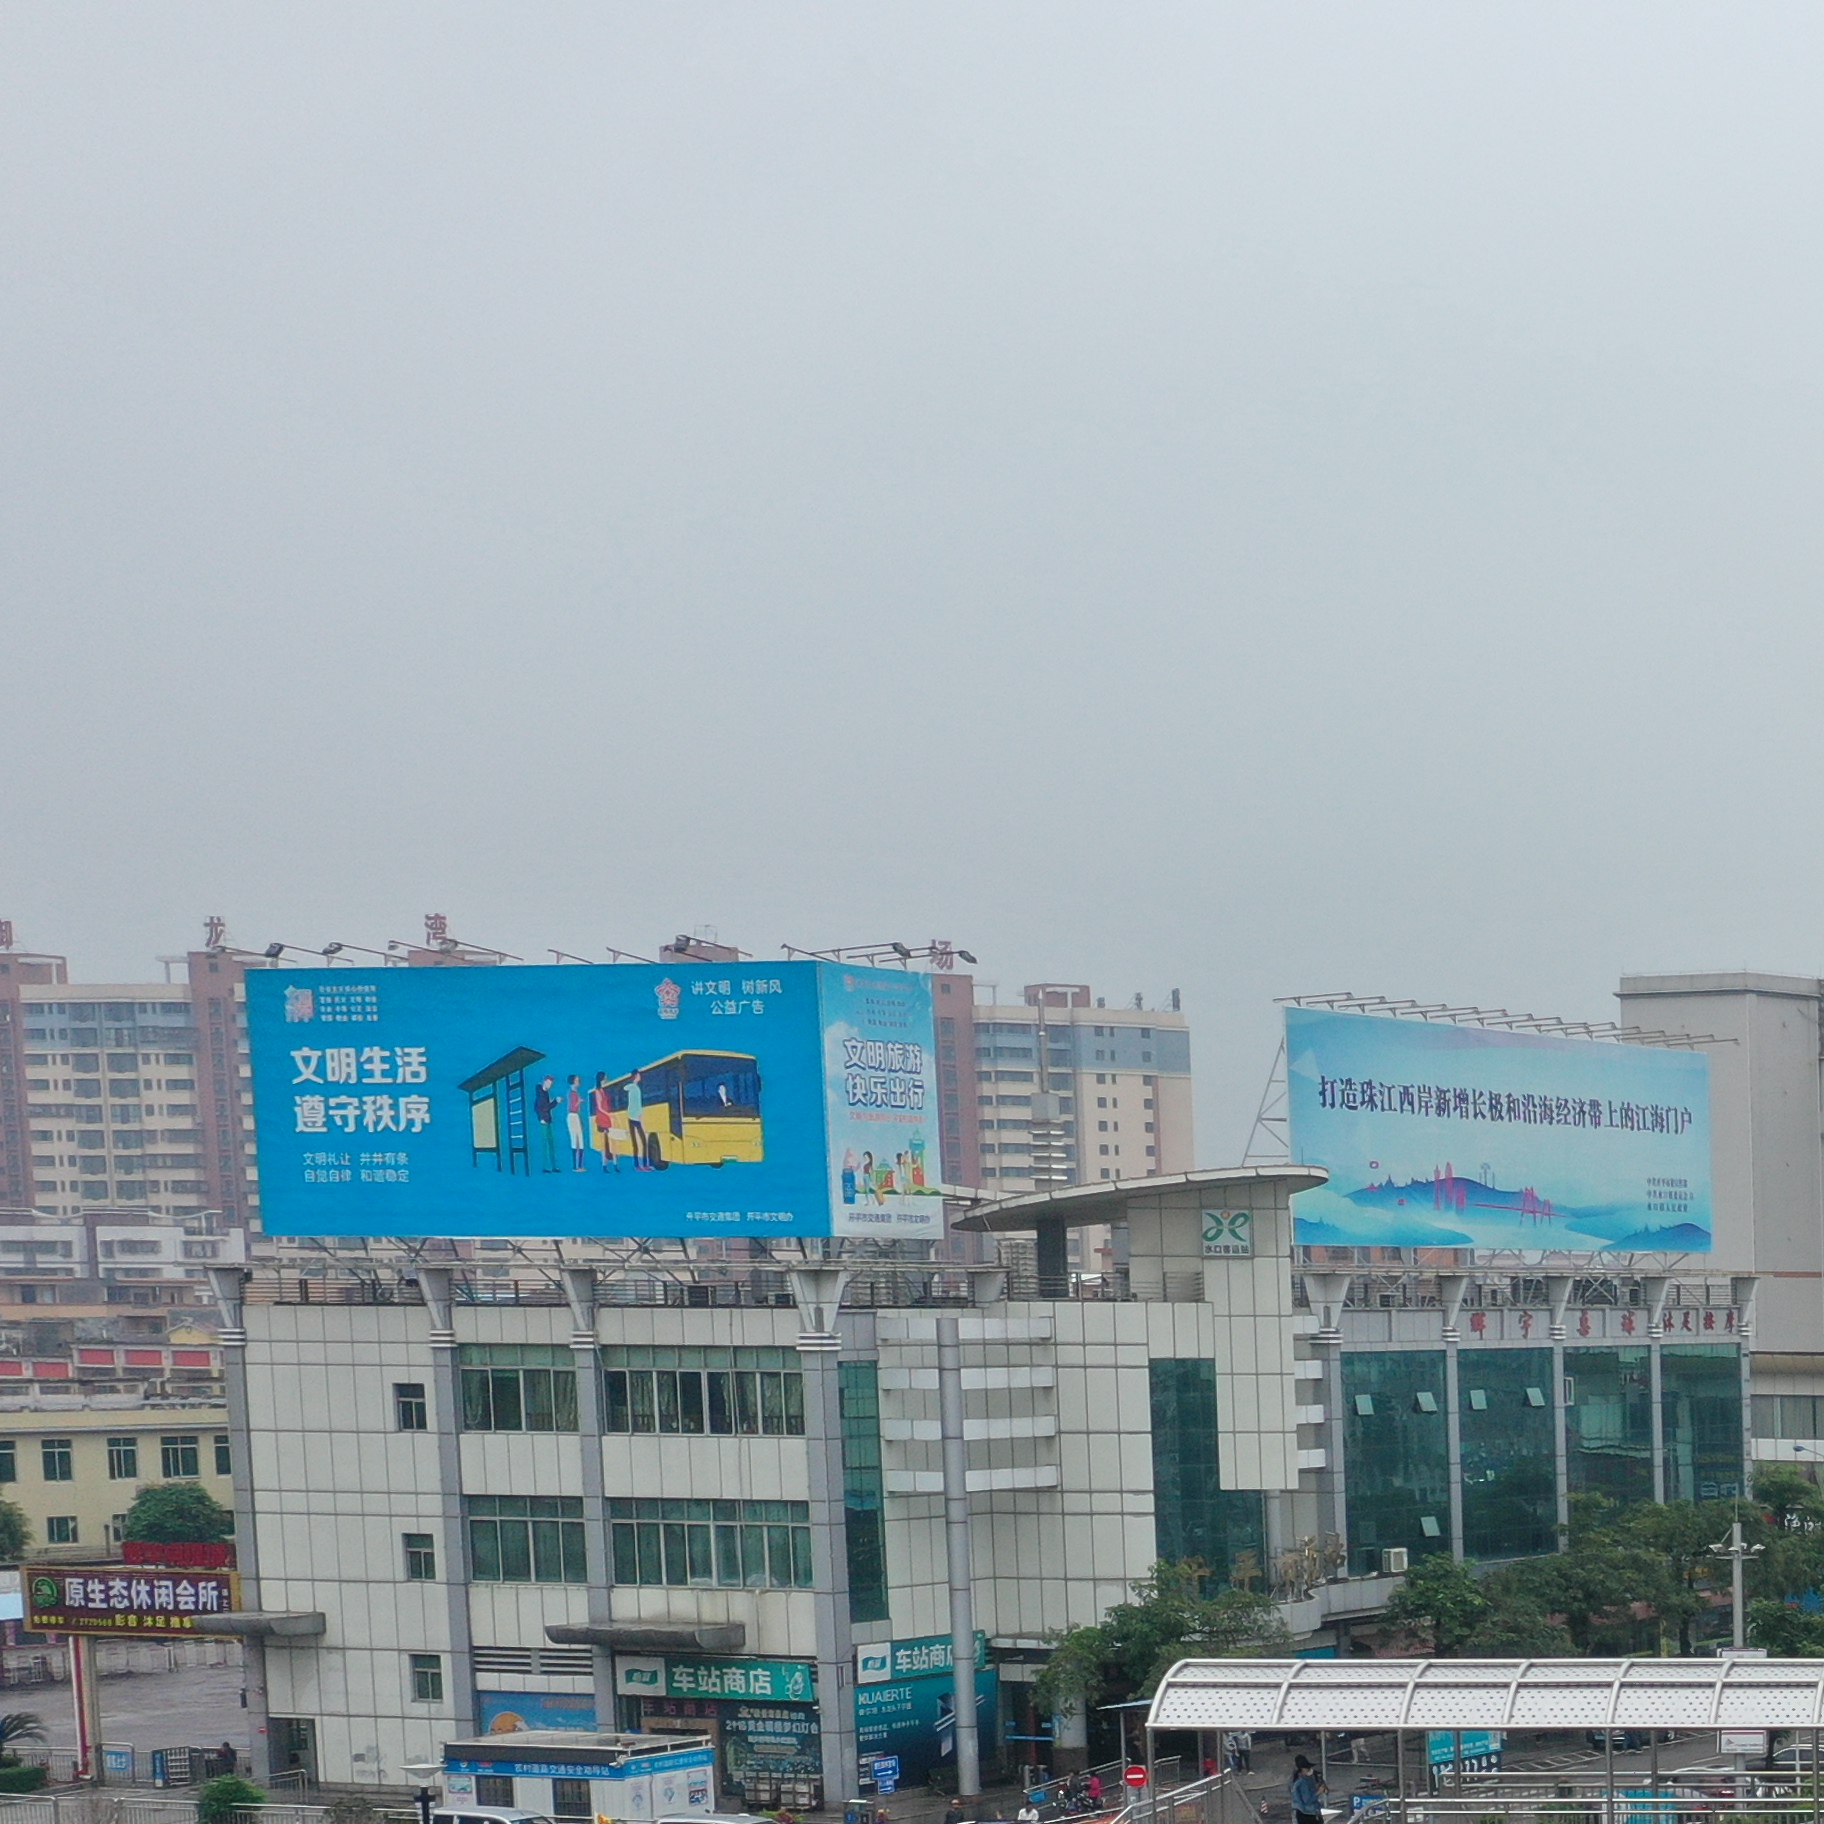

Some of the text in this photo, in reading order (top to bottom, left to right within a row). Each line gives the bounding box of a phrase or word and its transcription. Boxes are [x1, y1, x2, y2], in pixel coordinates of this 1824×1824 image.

[691, 979, 782, 995] 讲文明 树新风
[711, 1000, 764, 1014] 公益广告
[290, 1046, 428, 1084] 文明生活
[843, 1037, 922, 1074] 文明旅游
[846, 1073, 925, 1109] 快乐出行
[1318, 1074, 1693, 1136] 打造珠江西岸新增长极和沿海经济带上的江海门户
[294, 1095, 431, 1133] 遵守秩序
[303, 1152, 409, 1166] 文明礼让 井井有条
[304, 1169, 352, 1183] 自觉自律
[65, 1577, 218, 1611] 原生态休闲会所
[672, 1664, 773, 1695] 车站商店
